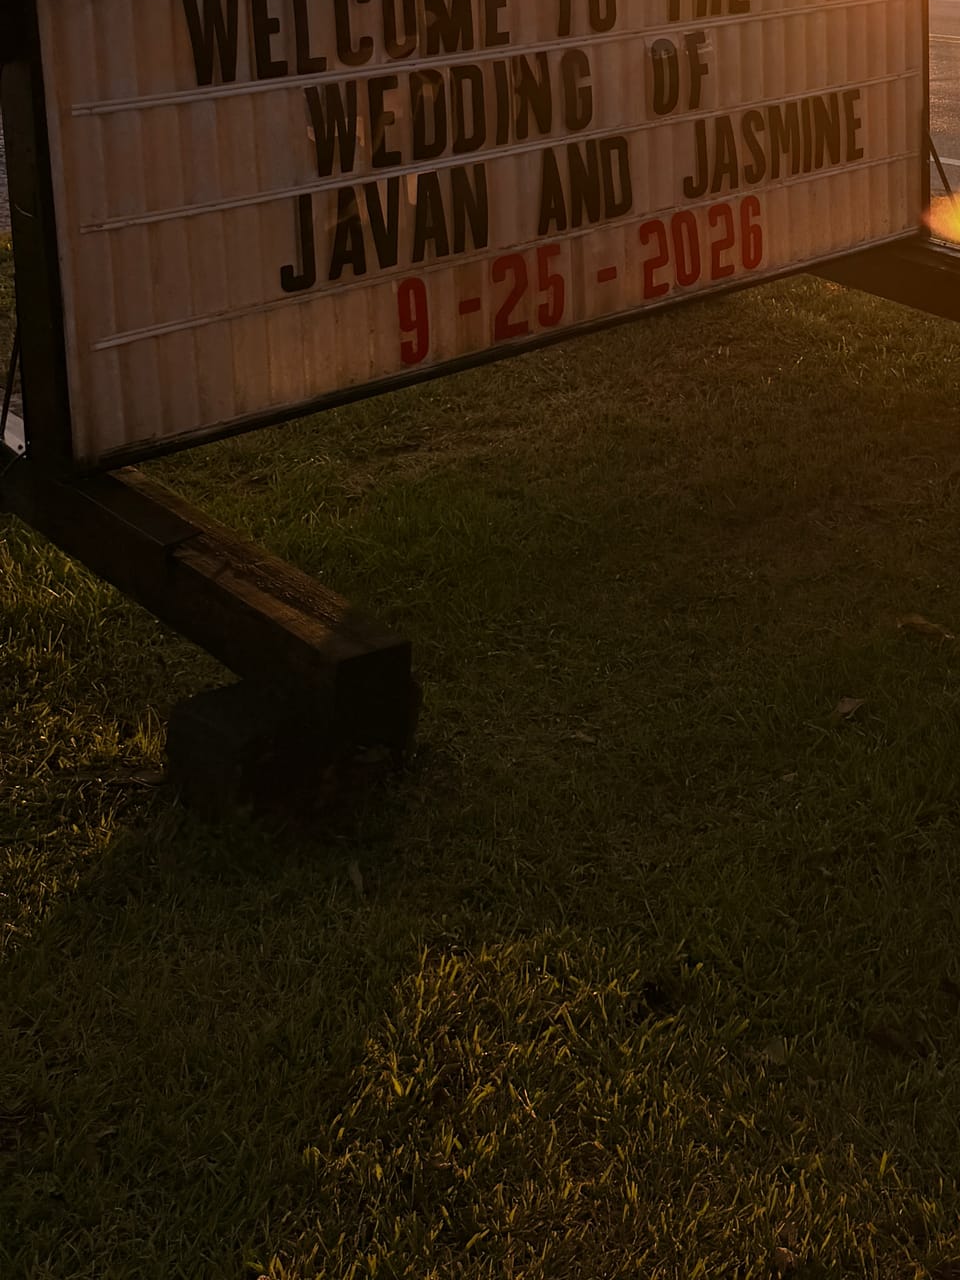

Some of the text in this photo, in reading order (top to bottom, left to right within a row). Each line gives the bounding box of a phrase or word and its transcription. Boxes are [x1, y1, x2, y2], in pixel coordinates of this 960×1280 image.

[280, 89, 864, 293] JAVAN AND JASMINE
[305, 32, 710, 177] WEDDING OF
